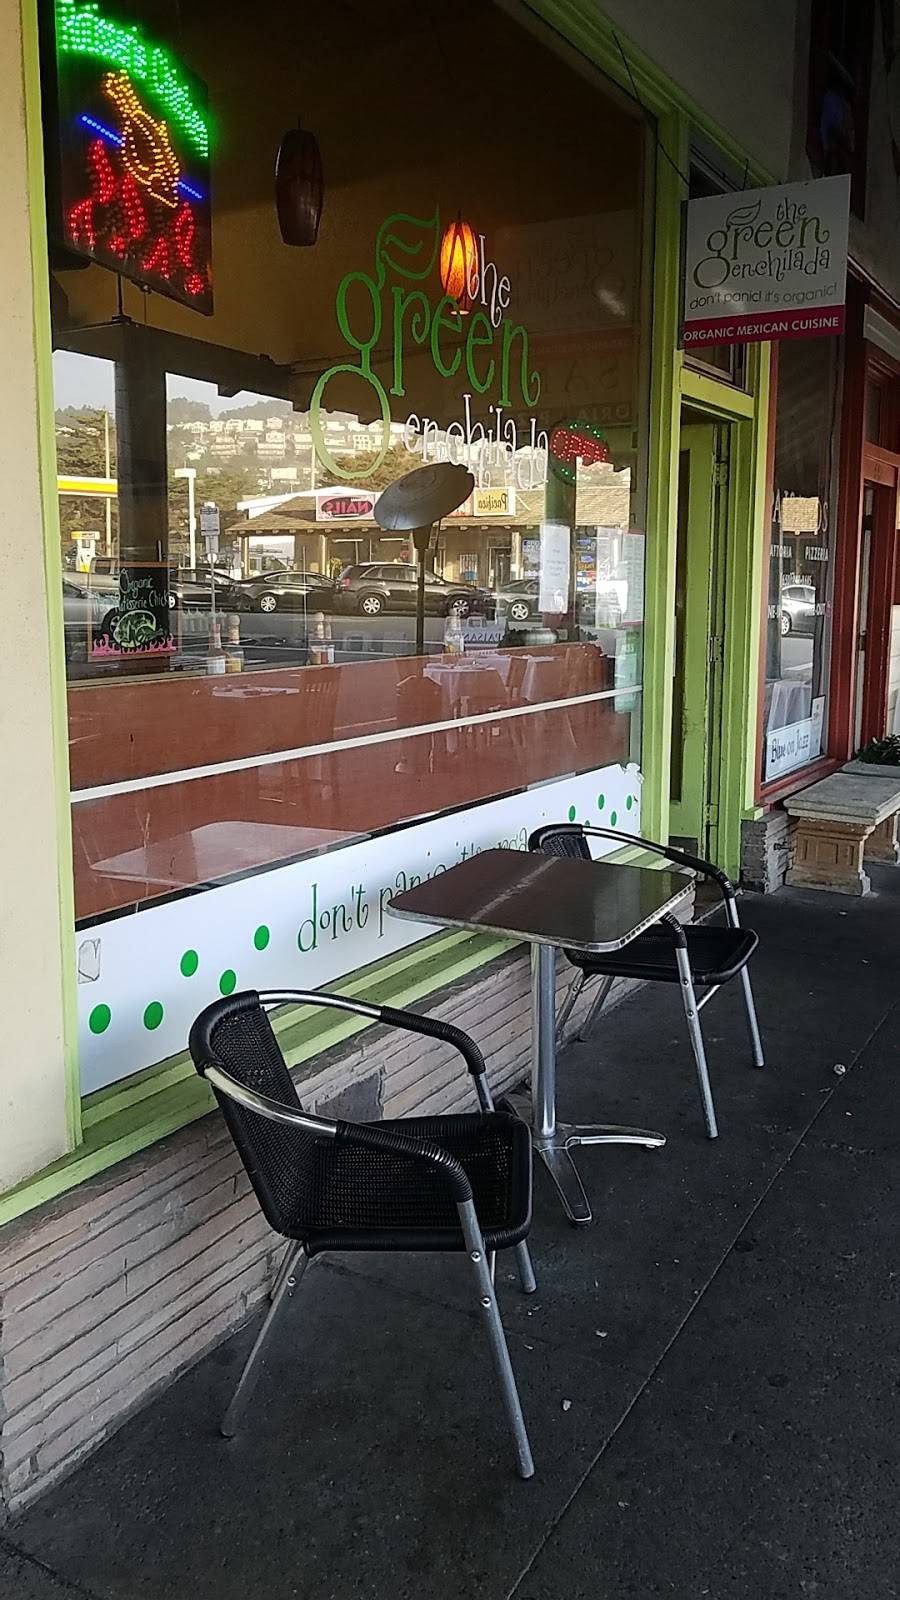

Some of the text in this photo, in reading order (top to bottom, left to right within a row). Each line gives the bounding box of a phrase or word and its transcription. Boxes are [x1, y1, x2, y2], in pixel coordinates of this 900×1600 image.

[776, 197, 807, 224] the
[693, 214, 830, 289] green
[731, 246, 830, 282] enchilada
[467, 234, 511, 328] the
[689, 292, 721, 310] don't
[765, 289, 780, 303] it's
[782, 282, 838, 304] organic!
[683, 317, 839, 341] ORGANIC MEXICAN CUISINE
[310, 268, 541, 479] green
[804, 546, 829, 561] PIZZERIA
[795, 729, 809, 757] Jazz
[296, 883, 370, 953] don't
